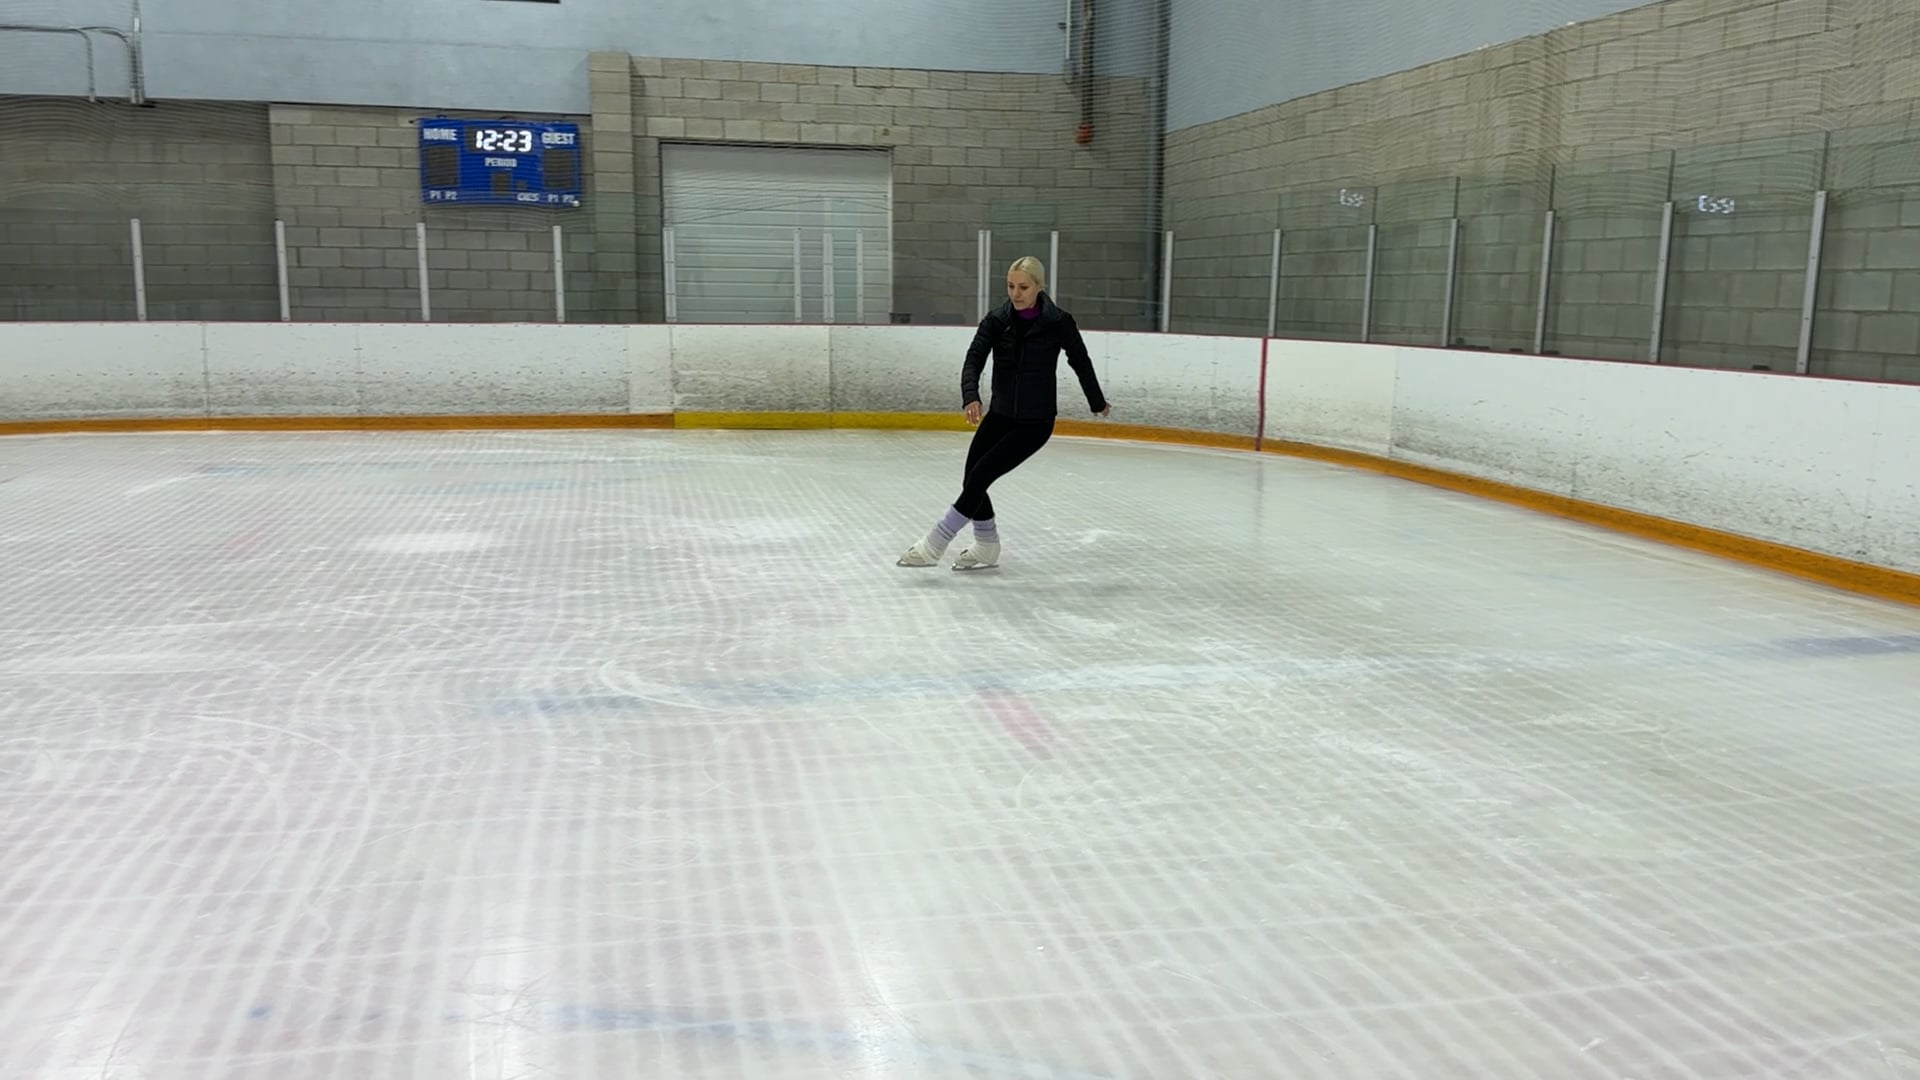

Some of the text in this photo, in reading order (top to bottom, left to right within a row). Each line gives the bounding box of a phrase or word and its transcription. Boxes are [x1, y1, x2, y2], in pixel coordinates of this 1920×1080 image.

[423, 128, 457, 141] HOME
[475, 130, 532, 152] 12:23
[541, 132, 575, 145] GUEST
[485, 157, 518, 168] PERIOD
[444, 191, 457, 201] P2
